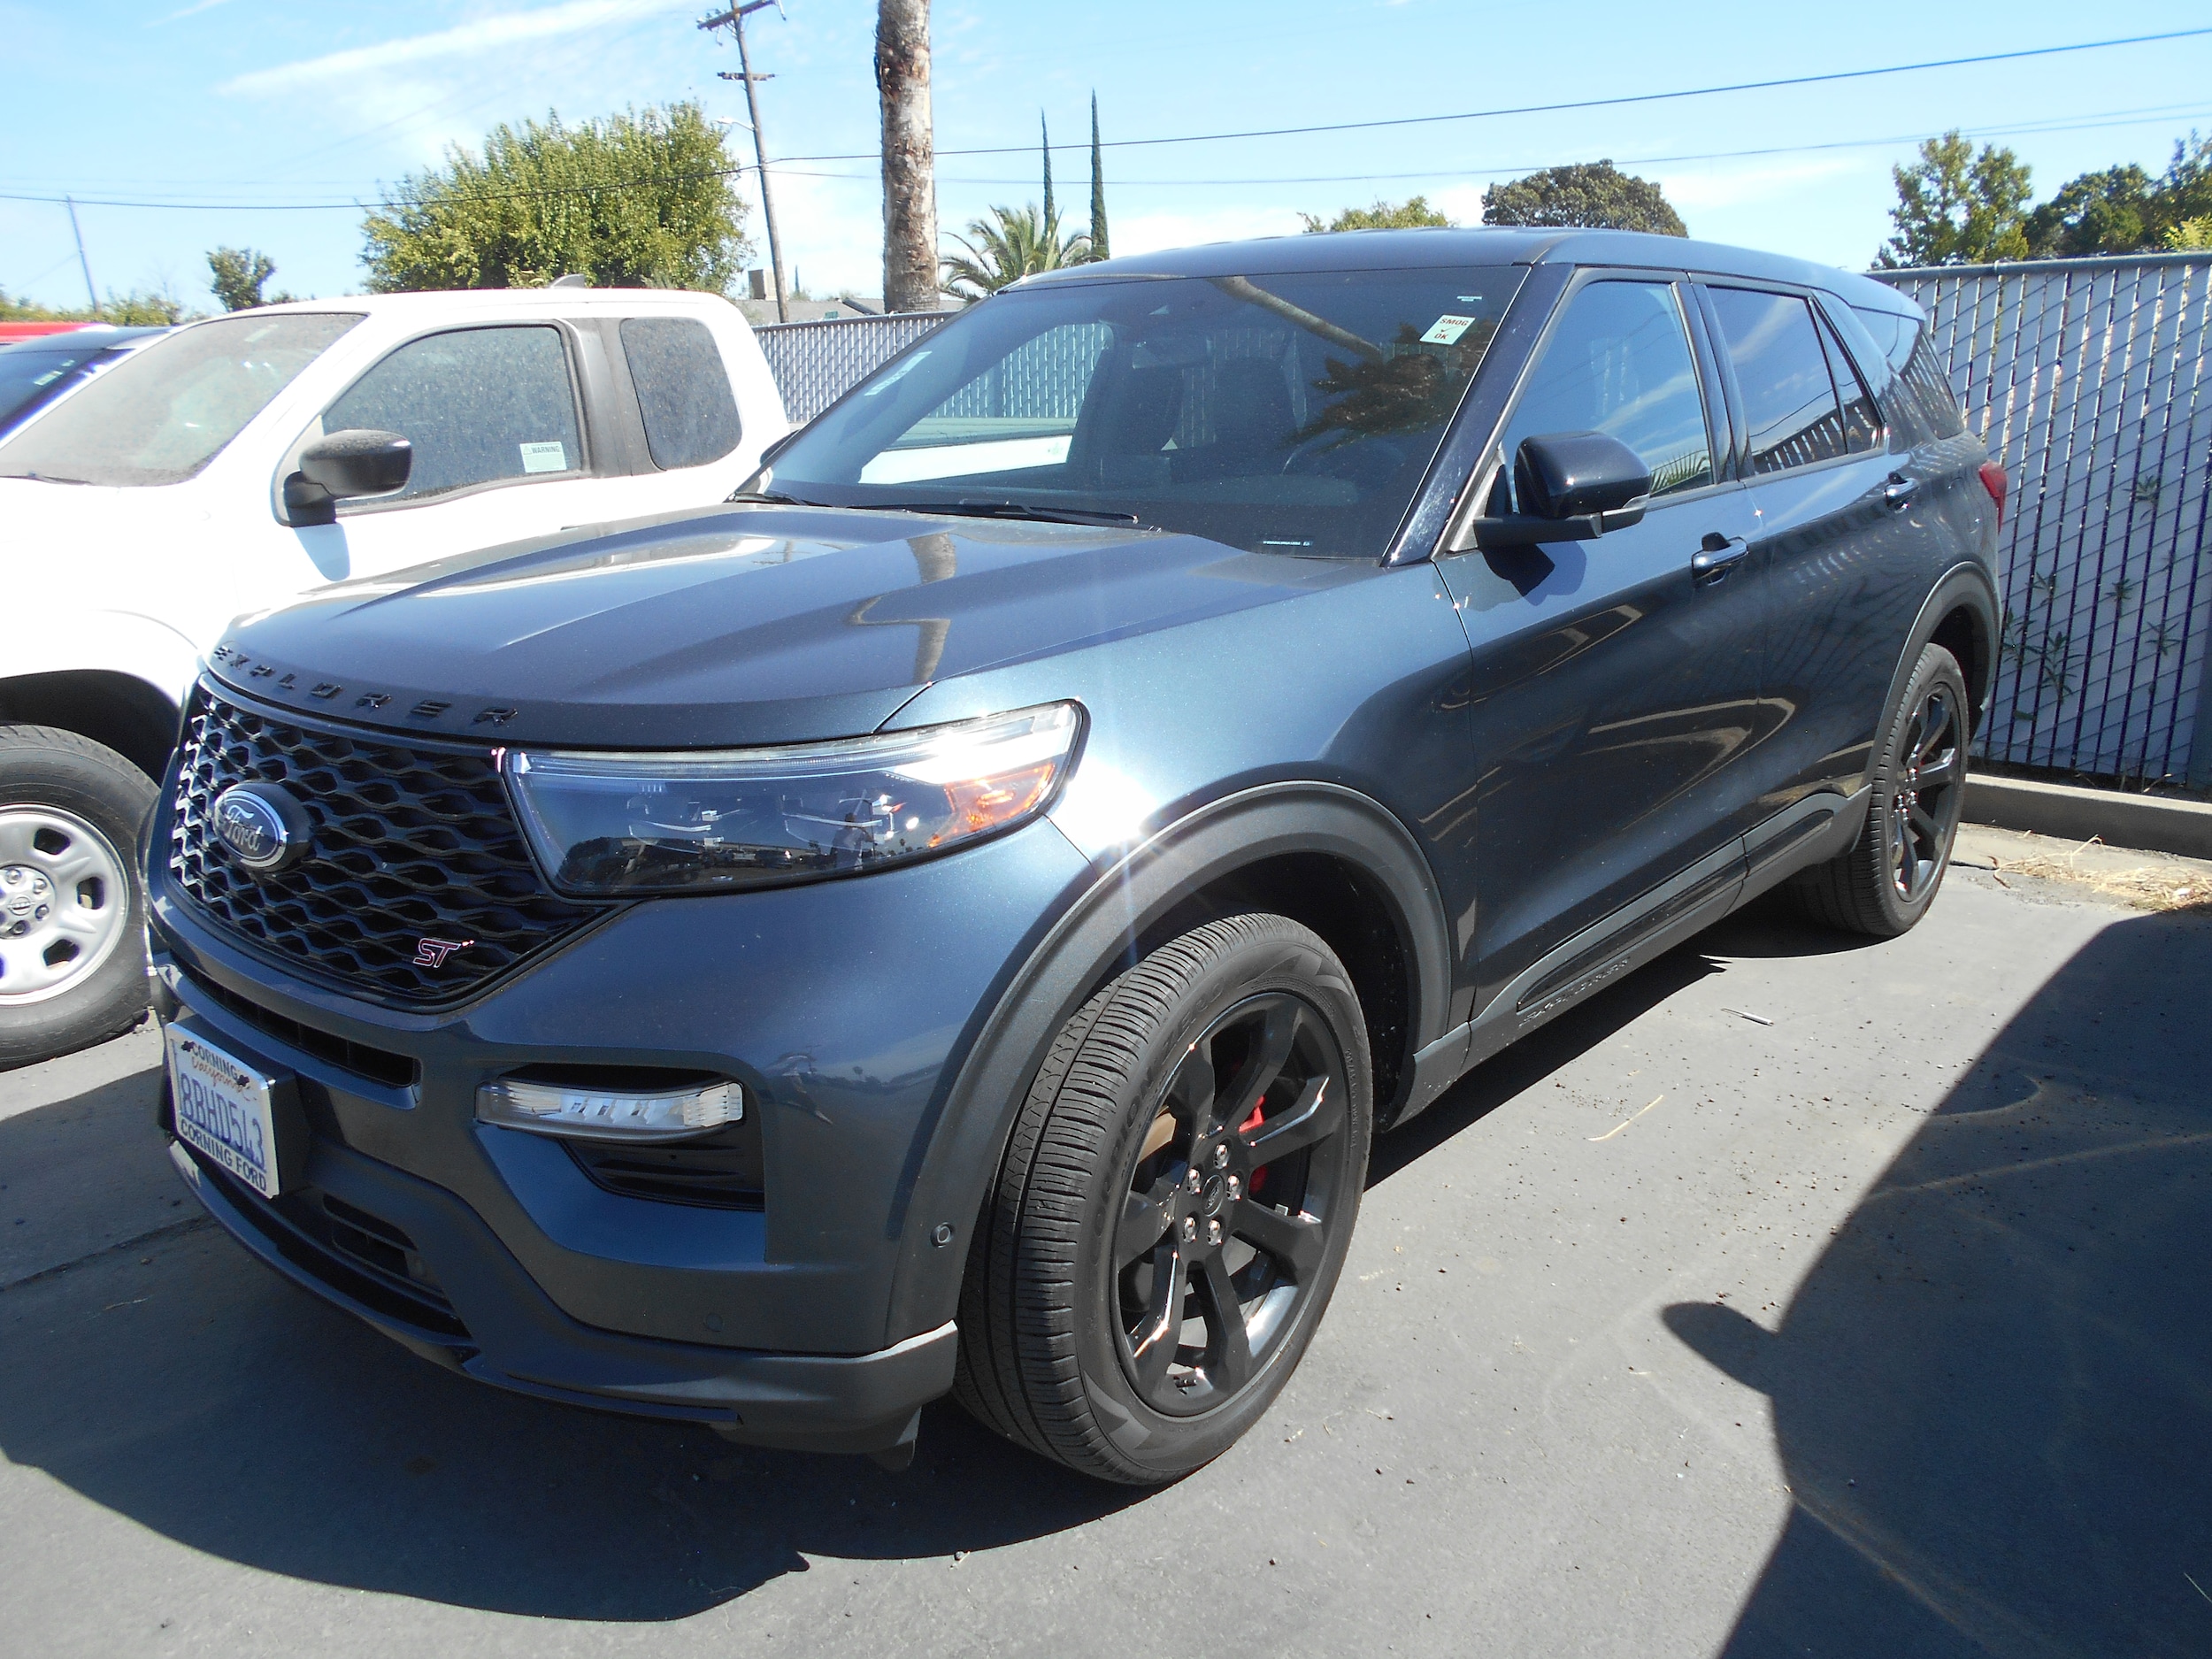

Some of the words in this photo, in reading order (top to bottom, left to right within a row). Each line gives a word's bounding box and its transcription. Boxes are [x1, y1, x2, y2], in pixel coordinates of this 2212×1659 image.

[212, 645, 518, 726] EXPLORER
[219, 804, 264, 851] Ford
[412, 938, 461, 969] ST
[191, 1042, 239, 1081] CORNING
[180, 1072, 264, 1169] 8BHD543
[180, 1118, 233, 1167] CORNING
[236, 1156, 266, 1192] FORD
